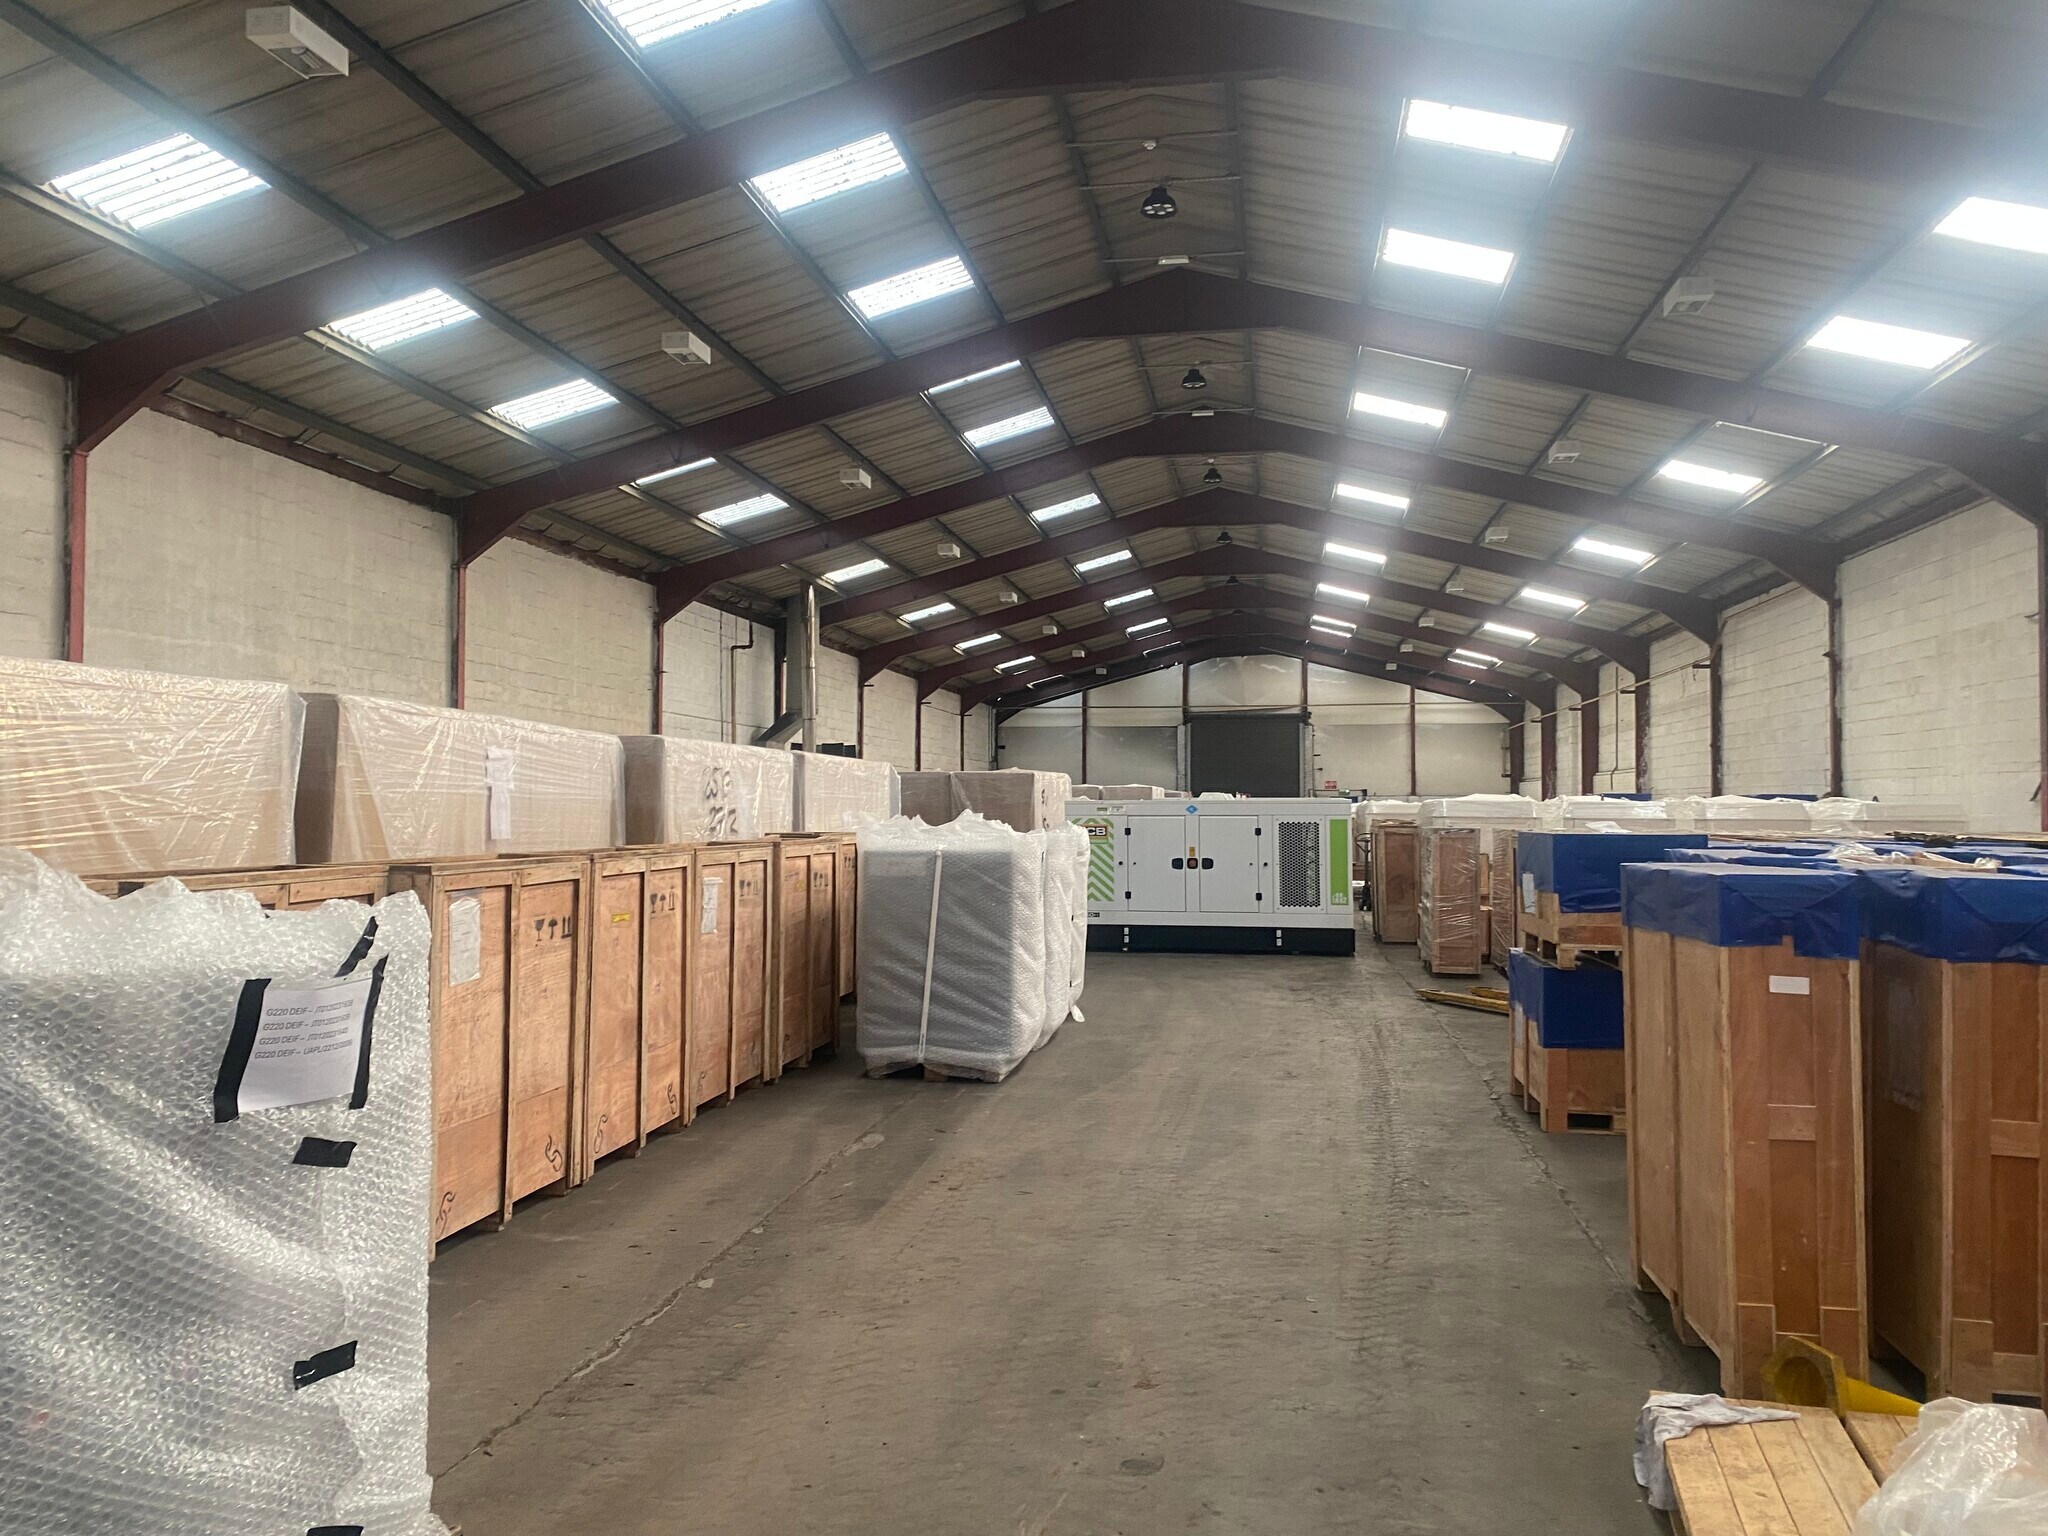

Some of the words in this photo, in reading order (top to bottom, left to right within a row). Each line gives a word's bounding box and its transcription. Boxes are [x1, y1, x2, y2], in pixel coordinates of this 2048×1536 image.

[1086, 826, 1106, 836] CB
[266, 1008, 288, 1017] G220
[263, 1022, 284, 1031] G220
[259, 1037, 280, 1046] G220
[254, 1051, 275, 1059] G220
